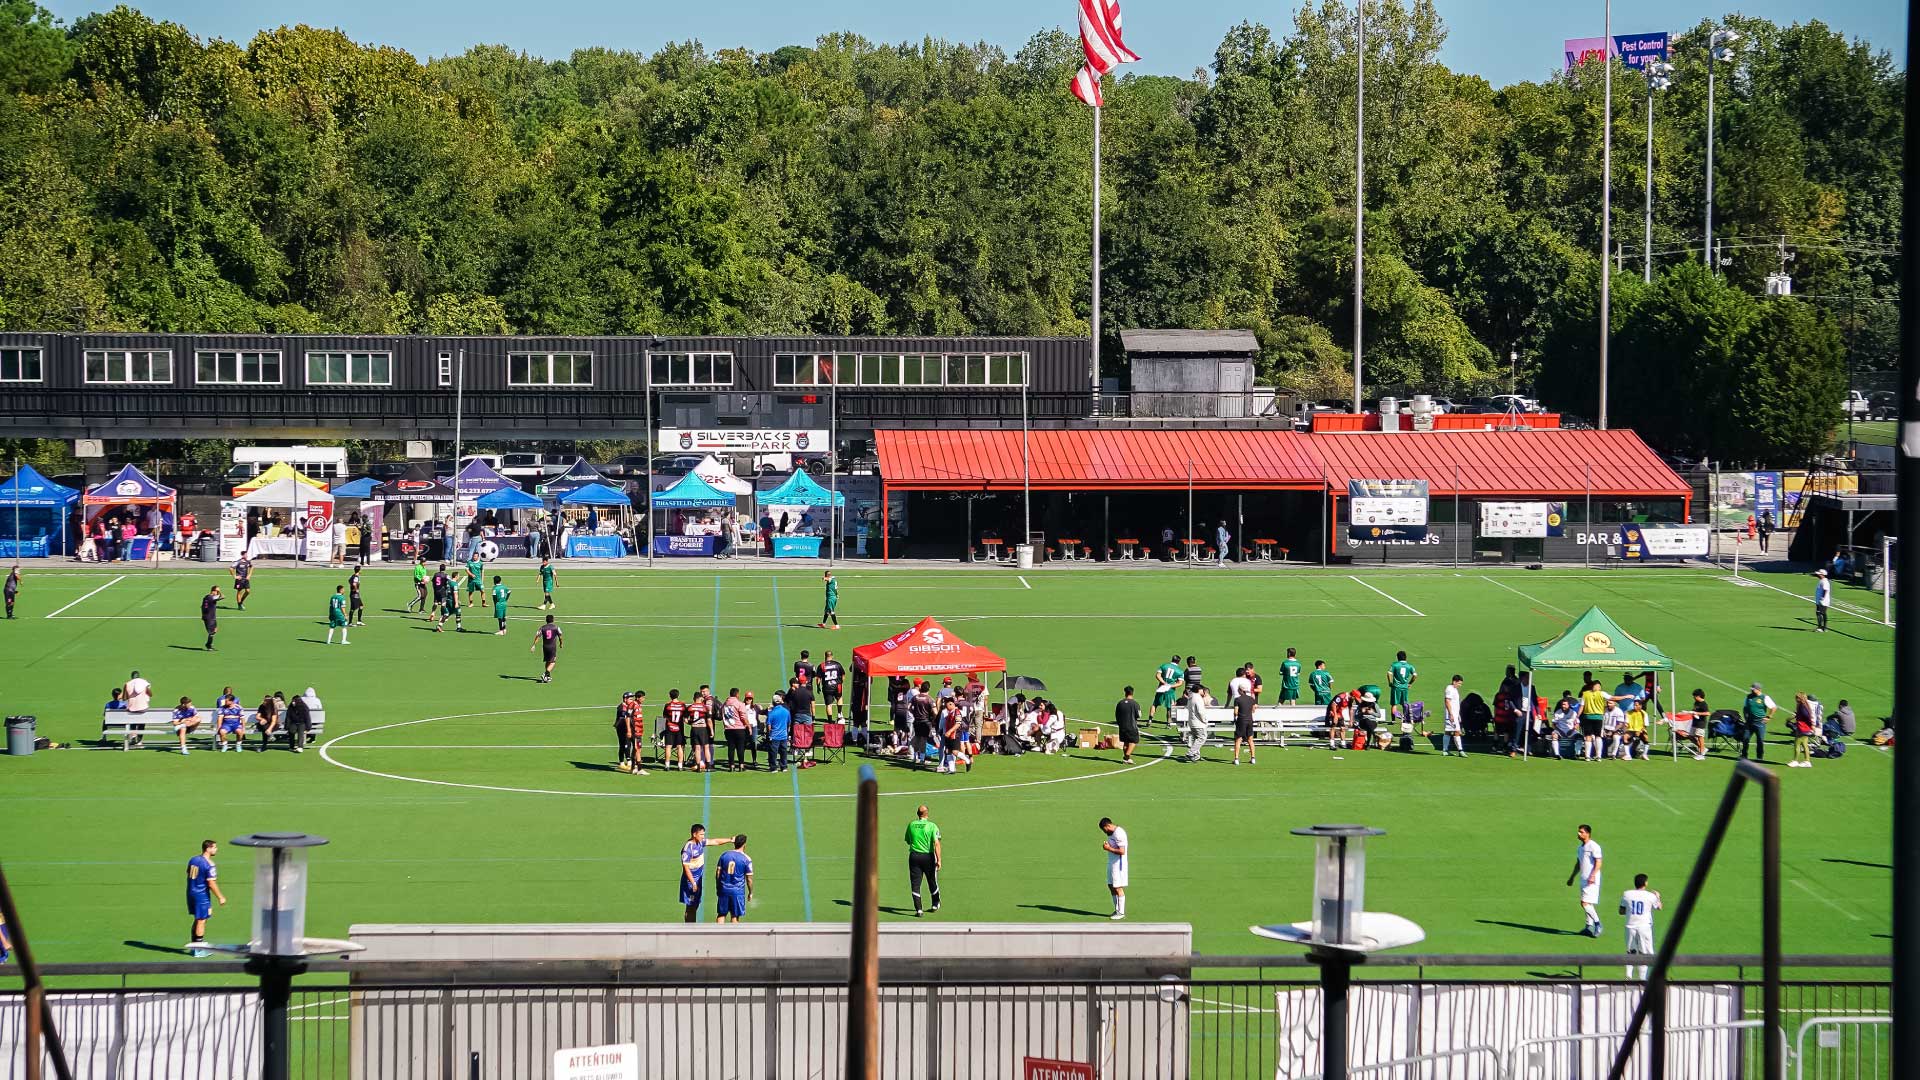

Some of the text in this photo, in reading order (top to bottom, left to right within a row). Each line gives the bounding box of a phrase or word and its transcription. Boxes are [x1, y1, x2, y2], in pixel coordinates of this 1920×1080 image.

[1622, 38, 1664, 51] Pest Control
[1628, 53, 1638, 64] for
[697, 432, 791, 441] SILVERBACKS
[751, 442, 791, 450] PARK
[692, 499, 702, 507] &
[1576, 533, 1622, 545] BAR &
[1587, 635, 1607, 646] CWM
[909, 644, 960, 652] GIBSON
[824, 670, 838, 681] 18
[1631, 900, 1644, 915] 10
